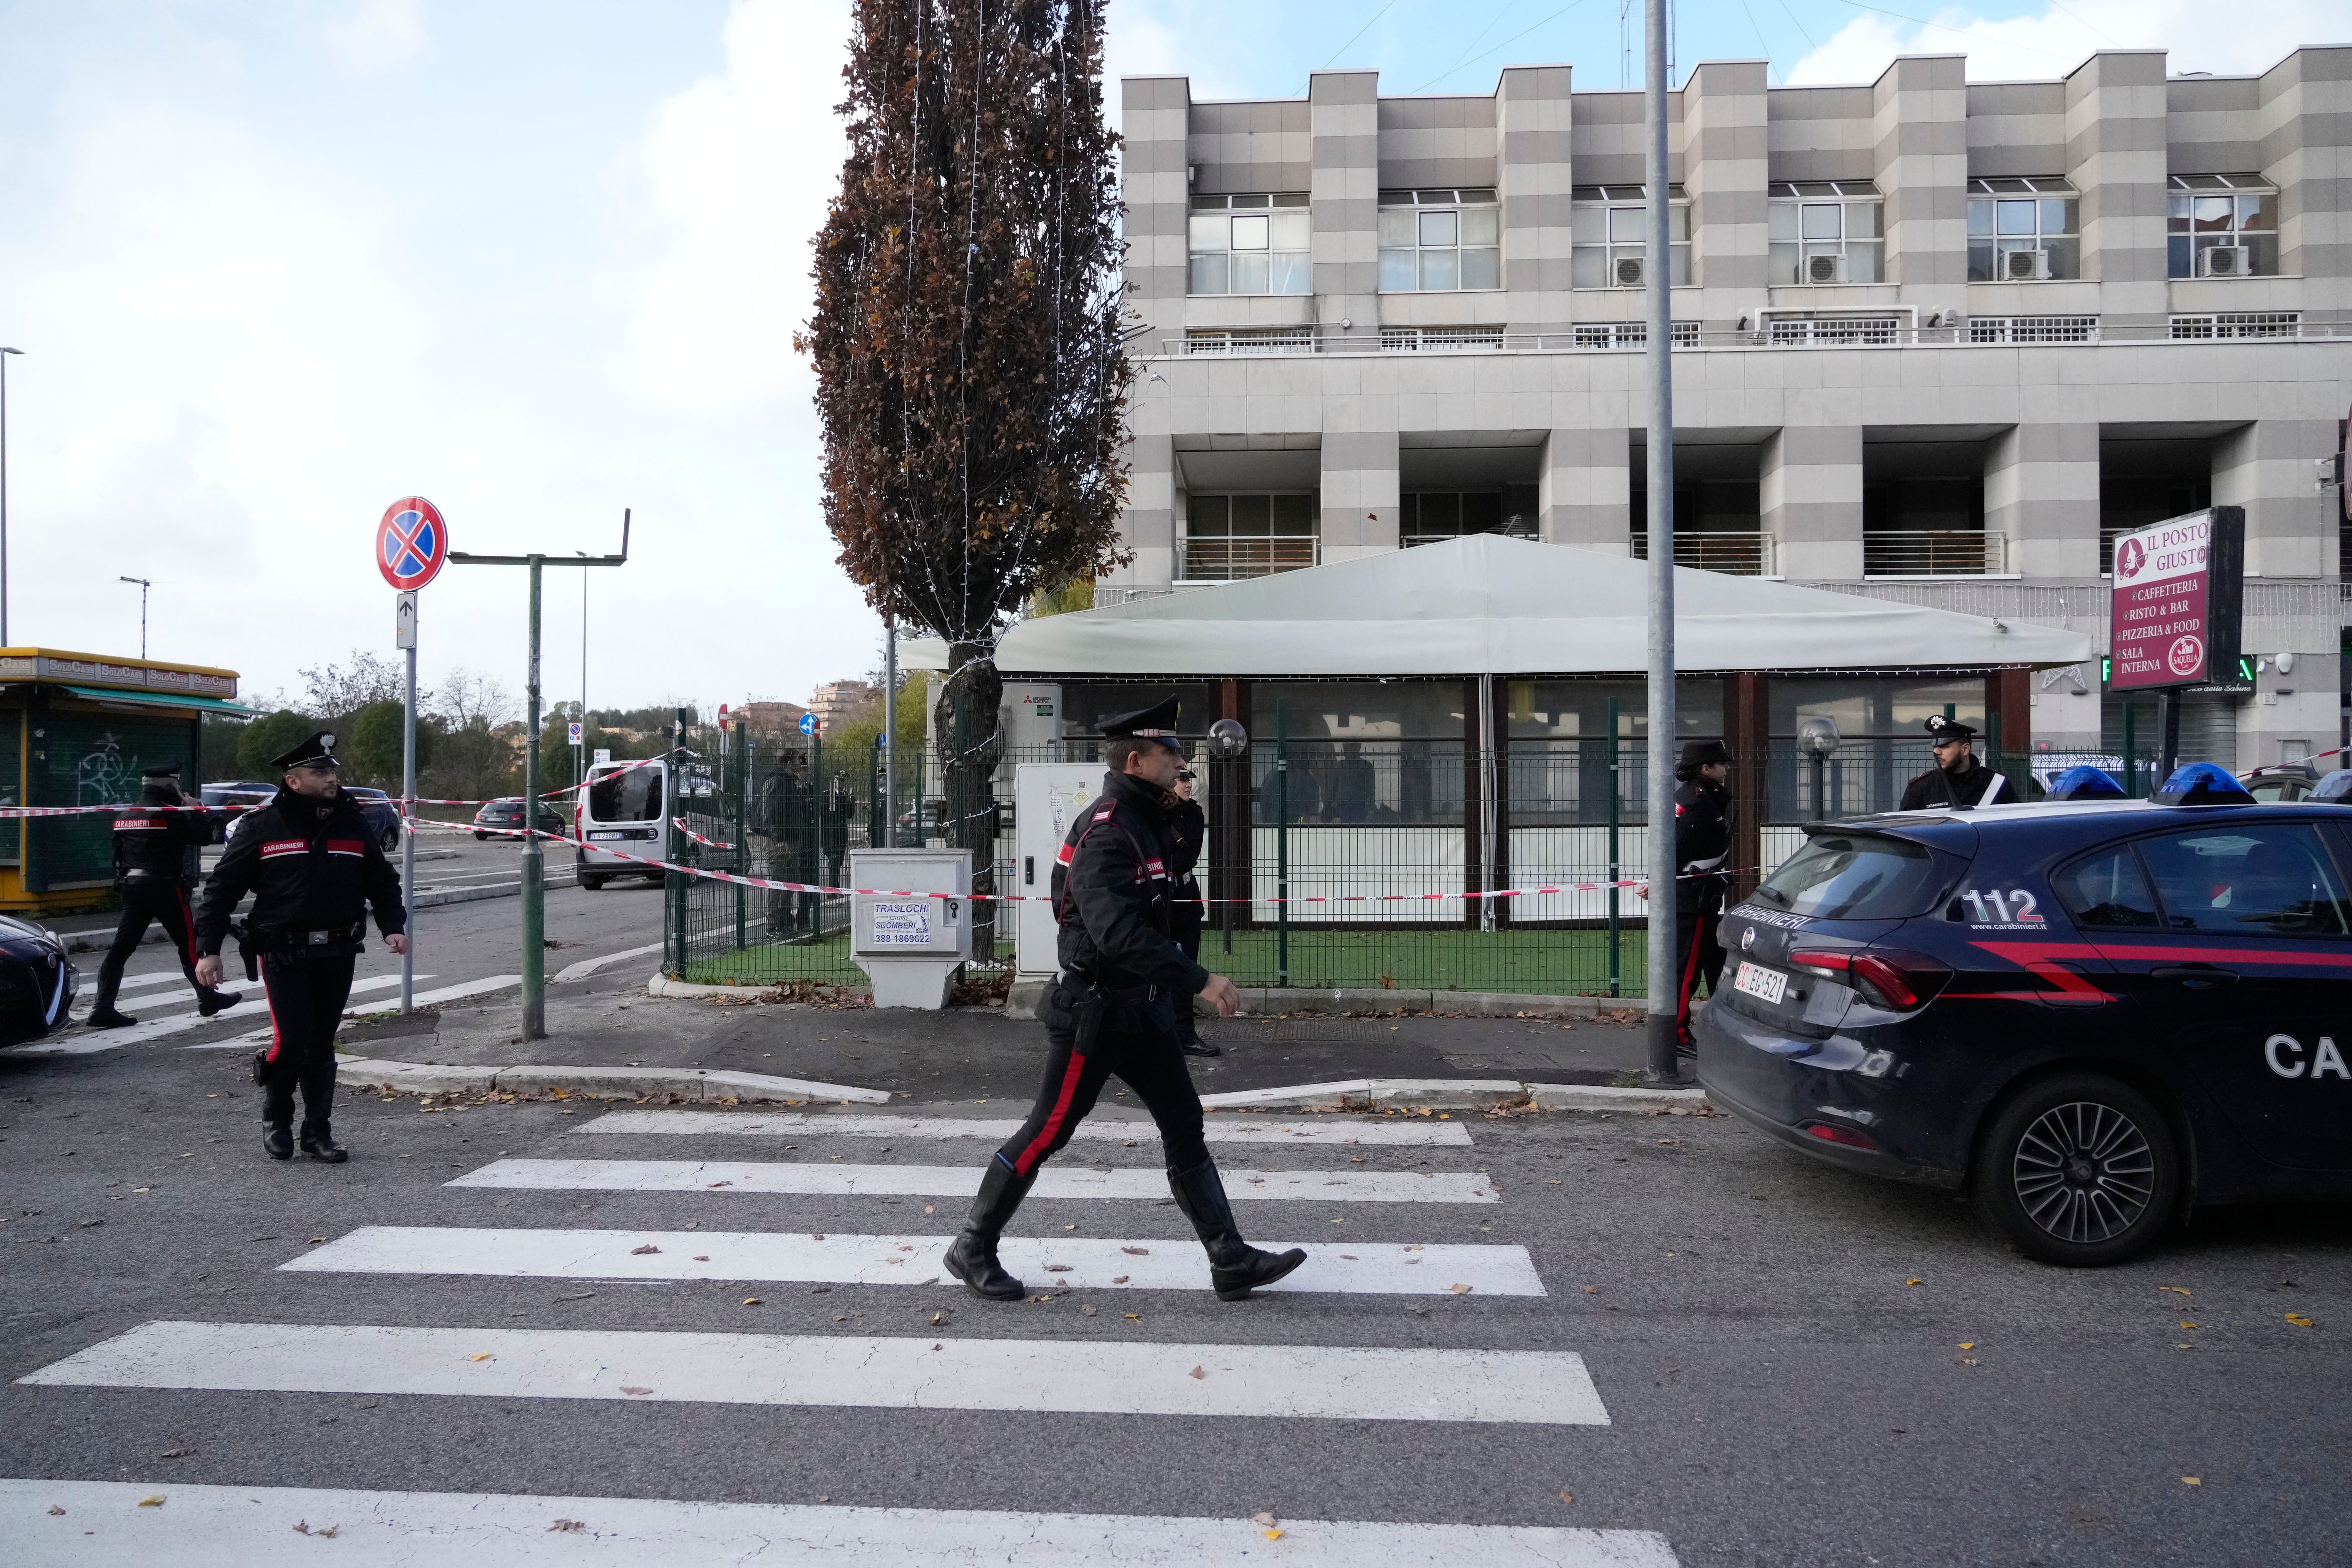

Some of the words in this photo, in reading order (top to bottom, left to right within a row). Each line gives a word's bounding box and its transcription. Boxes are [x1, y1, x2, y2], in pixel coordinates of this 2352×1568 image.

[2148, 536, 2159, 551] IL
[2162, 523, 2208, 547] POSTO
[2138, 579, 2198, 601] CAFFETTERIA
[2129, 606, 2156, 620] RISTO
[2160, 605, 2166, 615] &
[2170, 600, 2189, 614] BAR
[2122, 624, 2163, 641] PIZZERIA
[2165, 624, 2171, 634] &
[2173, 618, 2199, 633] FOOD
[2122, 646, 2143, 659] SALA
[2173, 654, 2197, 666] SAQUELLA
[2121, 659, 2160, 673] INTERNA
[2224, 683, 2251, 691] Sabine
[263, 842, 304, 853] CARABINIERI
[876, 904, 929, 913] TRASLOCHI
[1962, 889, 2044, 922] 112
[1730, 904, 1813, 929] CARABINIERI
[1737, 965, 1749, 988] CC
[1749, 969, 1763, 992] EG
[1763, 973, 1783, 1000] 521
[2265, 1034, 2352, 1080] CA
